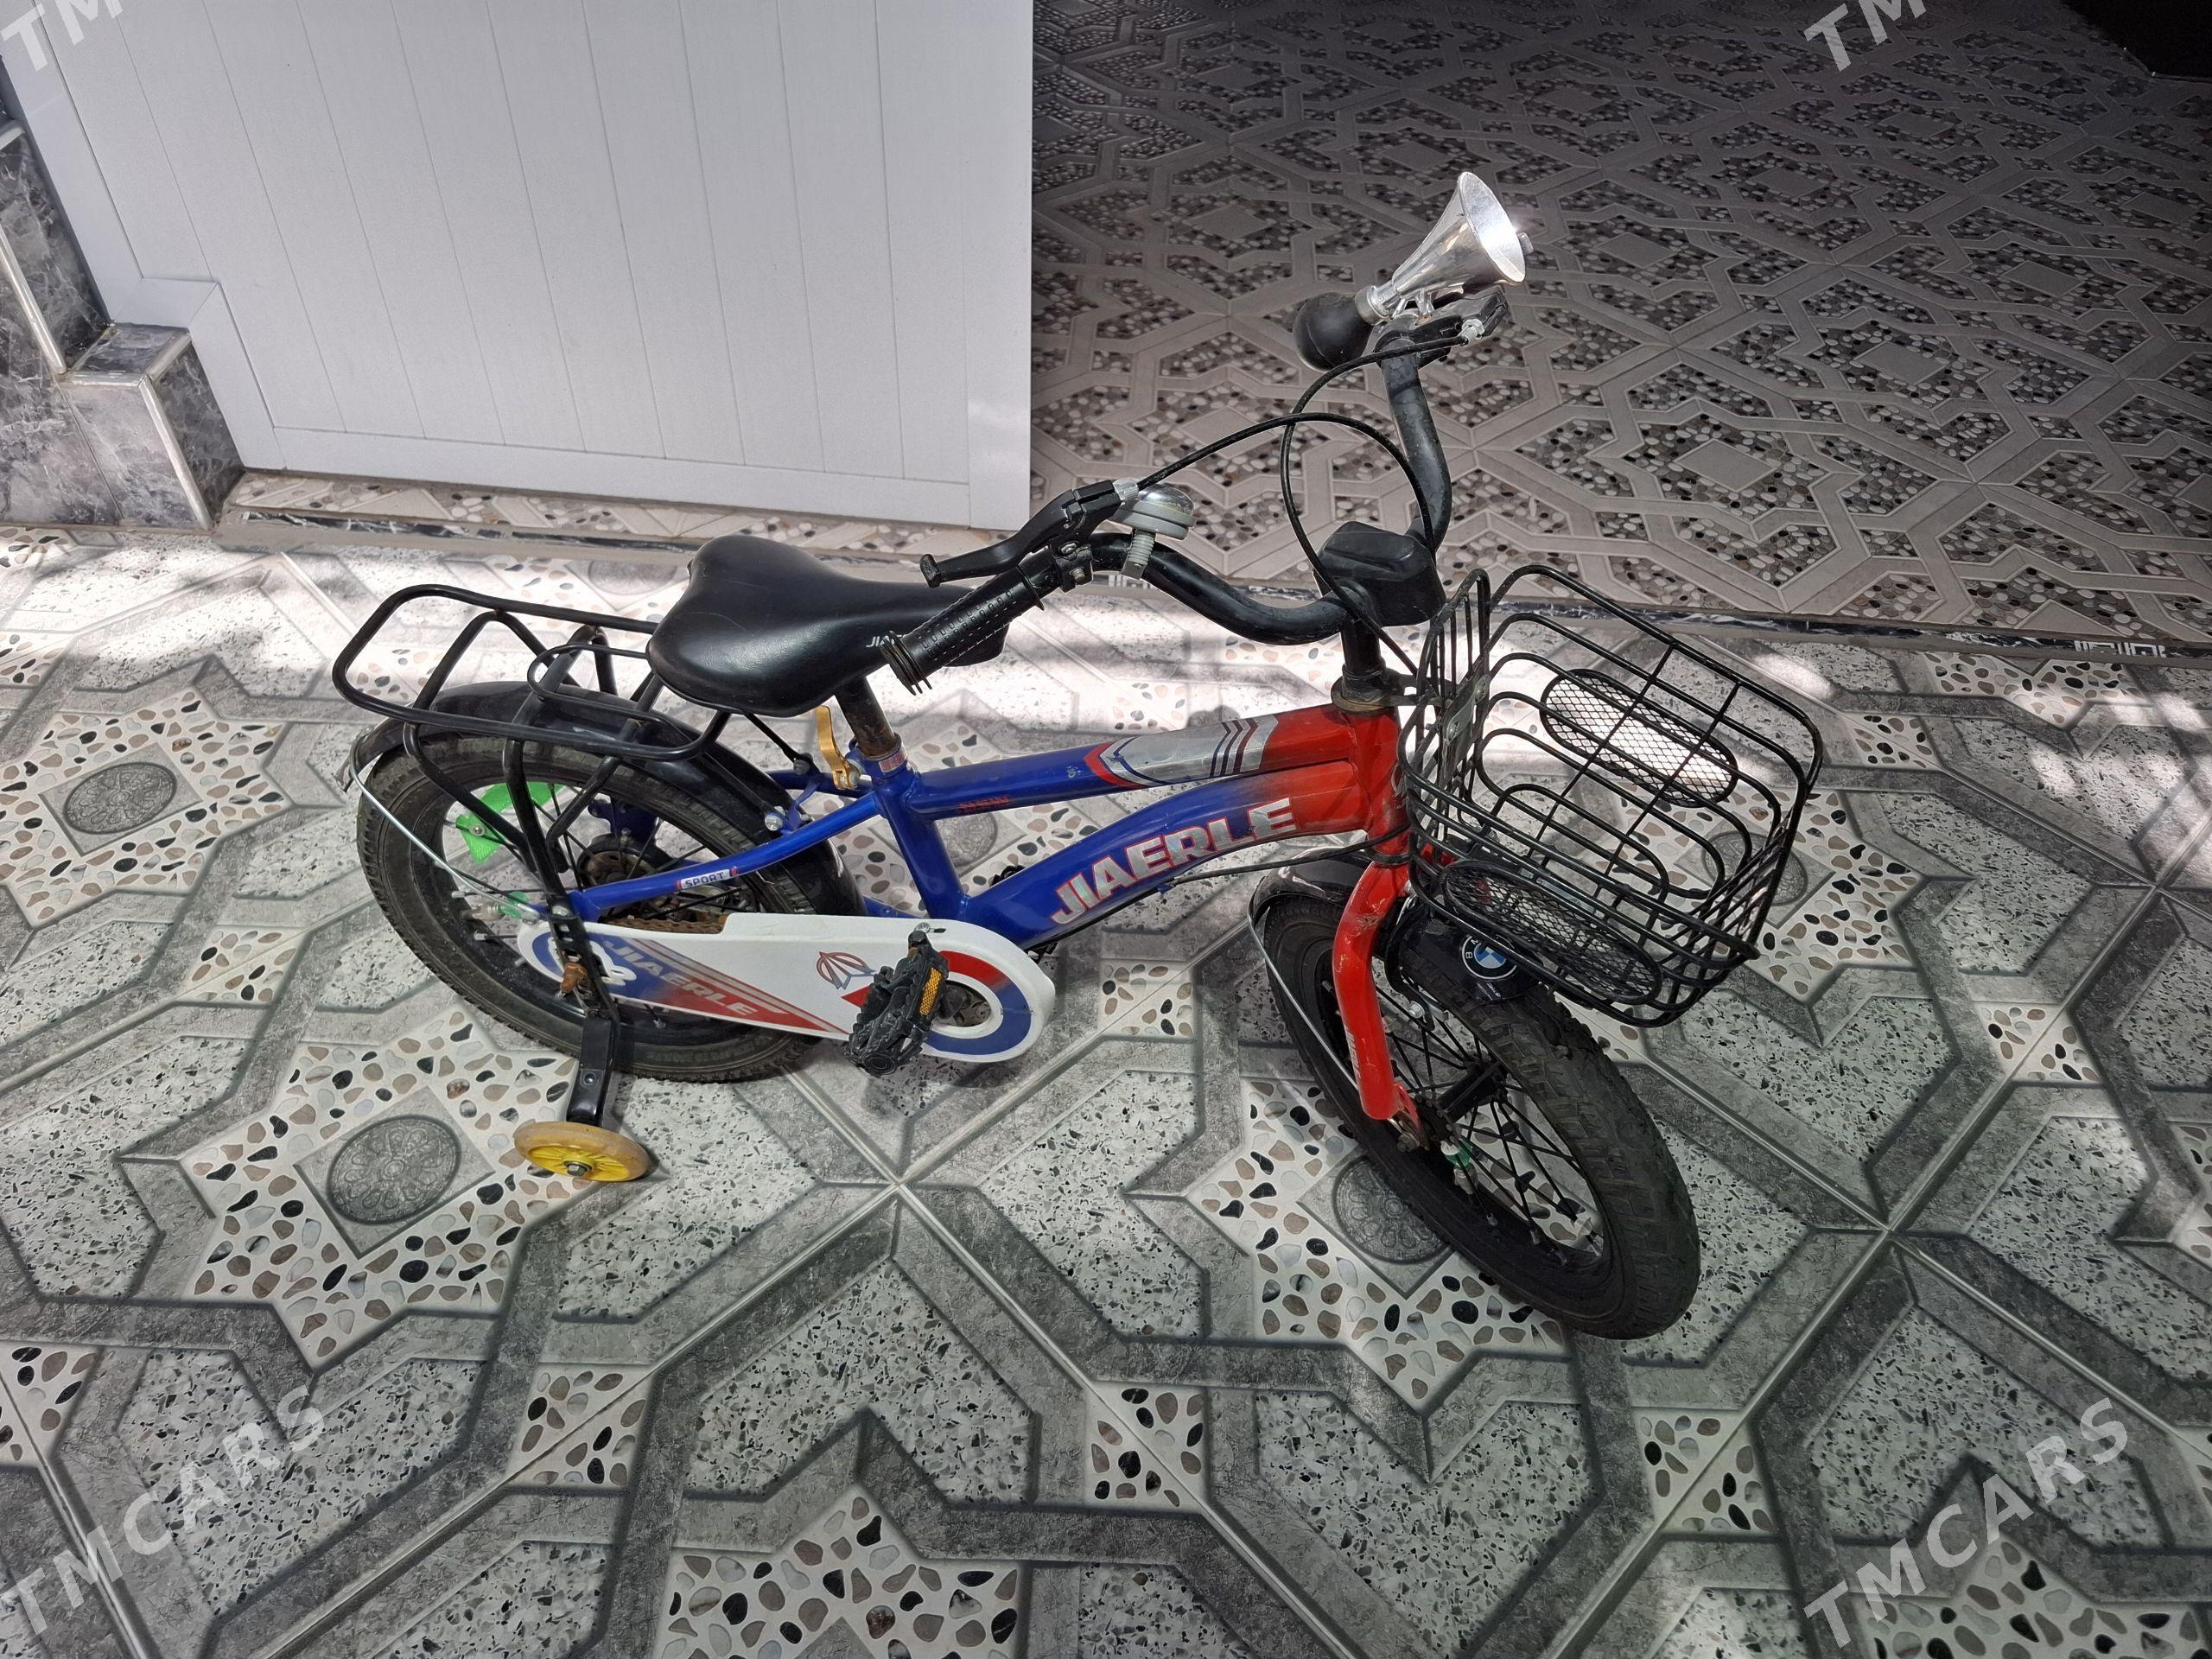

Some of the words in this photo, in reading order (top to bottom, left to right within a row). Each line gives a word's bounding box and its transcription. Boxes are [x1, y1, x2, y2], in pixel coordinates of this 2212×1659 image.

[684, 871, 724, 887] SPORT
[1052, 798, 1297, 925] JIAERLE
[604, 940, 759, 1016] JIAERLE
